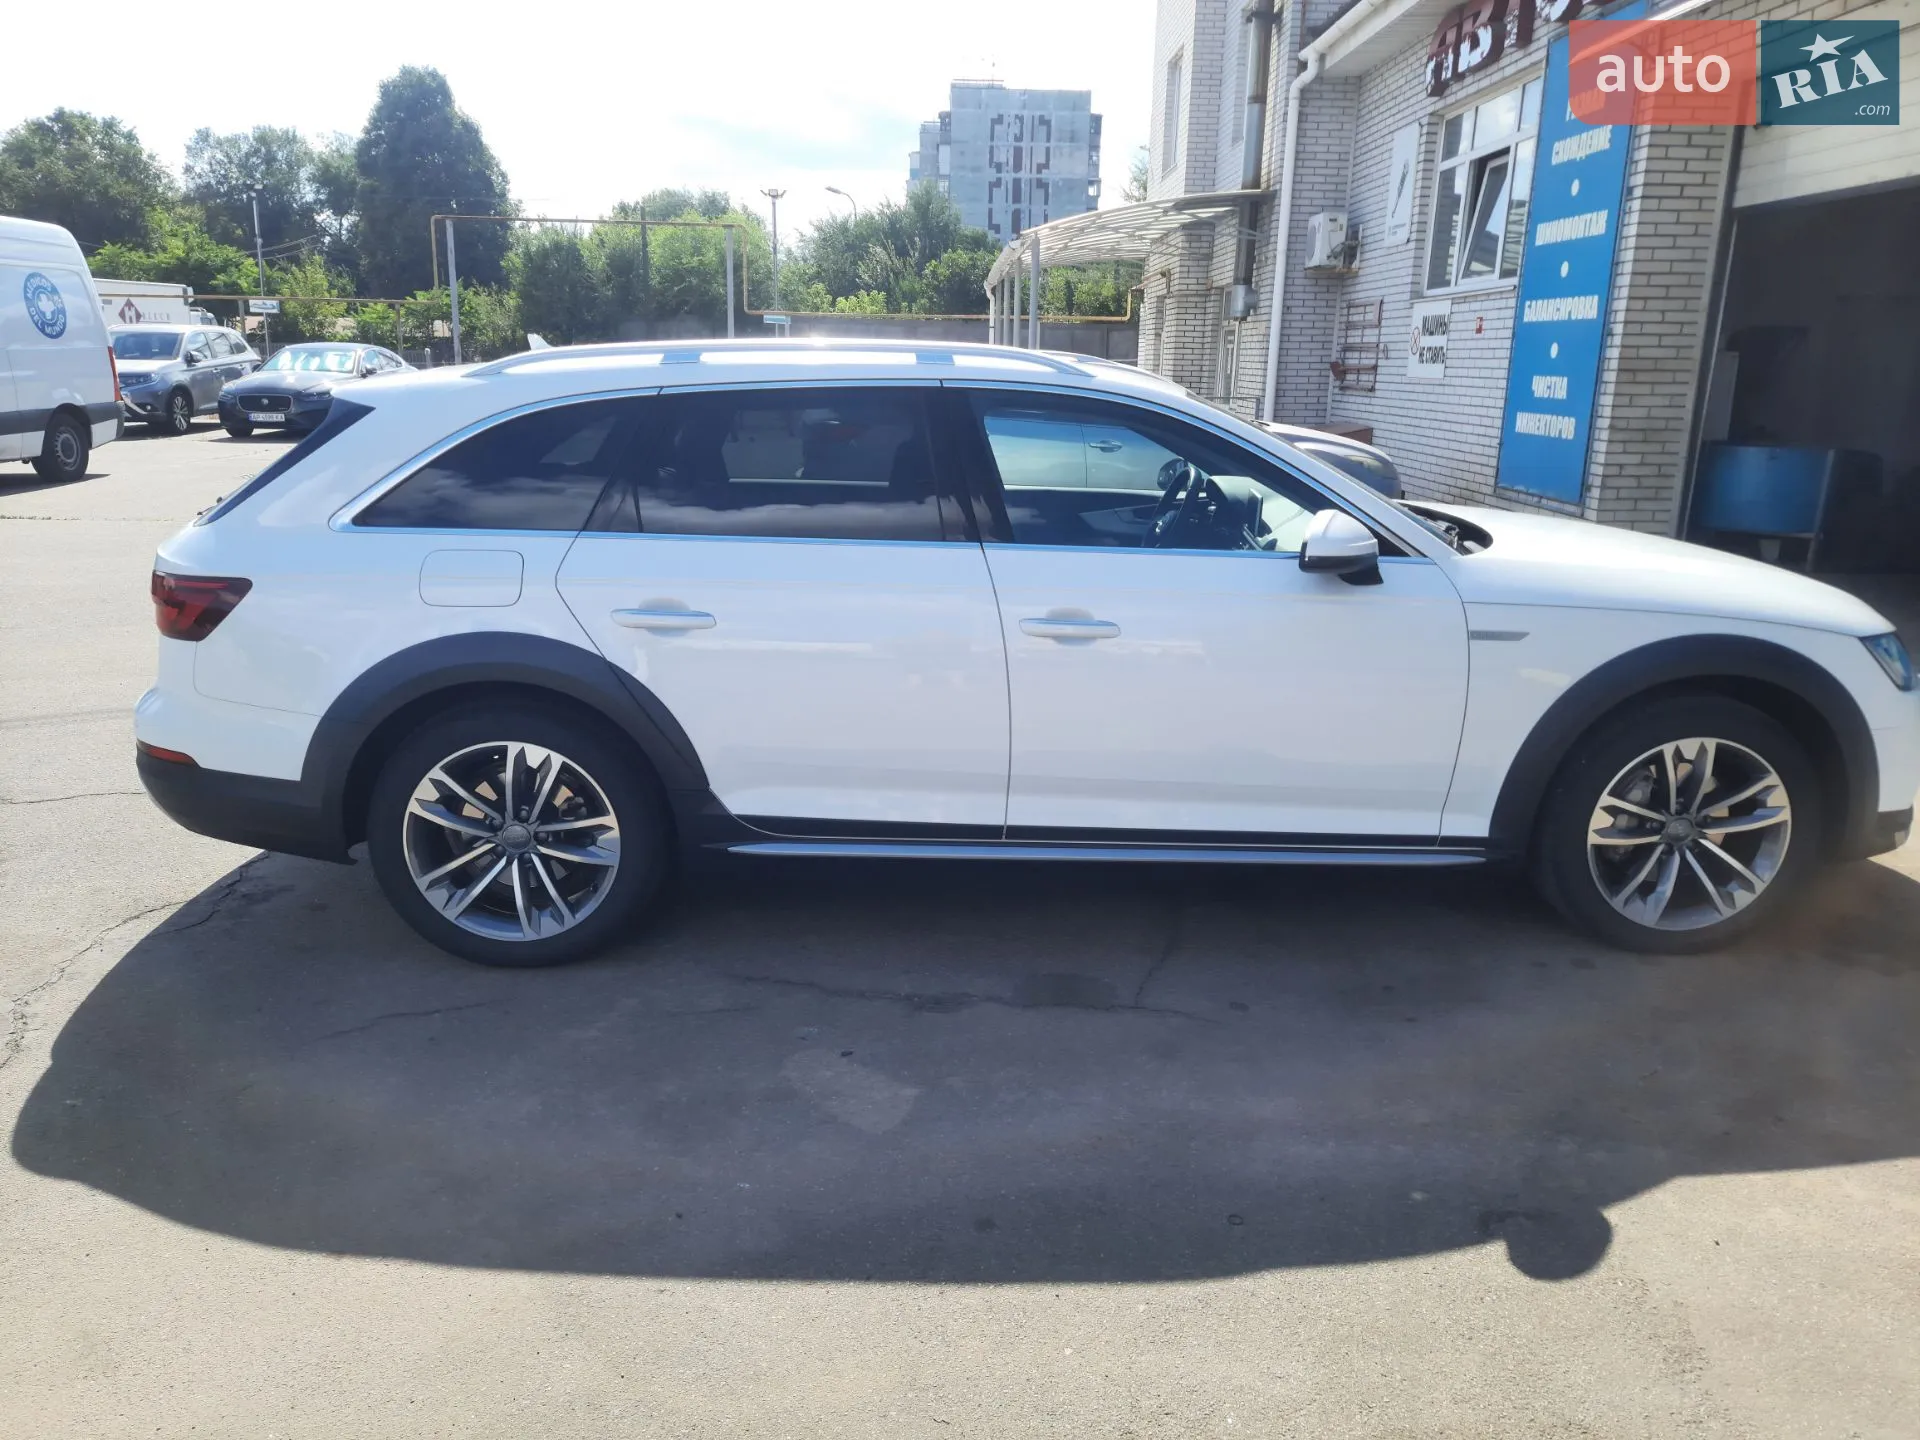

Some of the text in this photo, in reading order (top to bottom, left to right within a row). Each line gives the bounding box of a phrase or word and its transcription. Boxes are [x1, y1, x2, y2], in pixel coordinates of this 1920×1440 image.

[1535, 209, 1608, 246] ШИНОМОНТАЖ
[1523, 295, 1599, 322] БАЛАНСИРОВКА
[1421, 314, 1450, 337] МАШИНЫ
[1531, 375, 1569, 400] ЧИСТКА
[1515, 411, 1576, 440] ИНЖЕКТОРОВ
